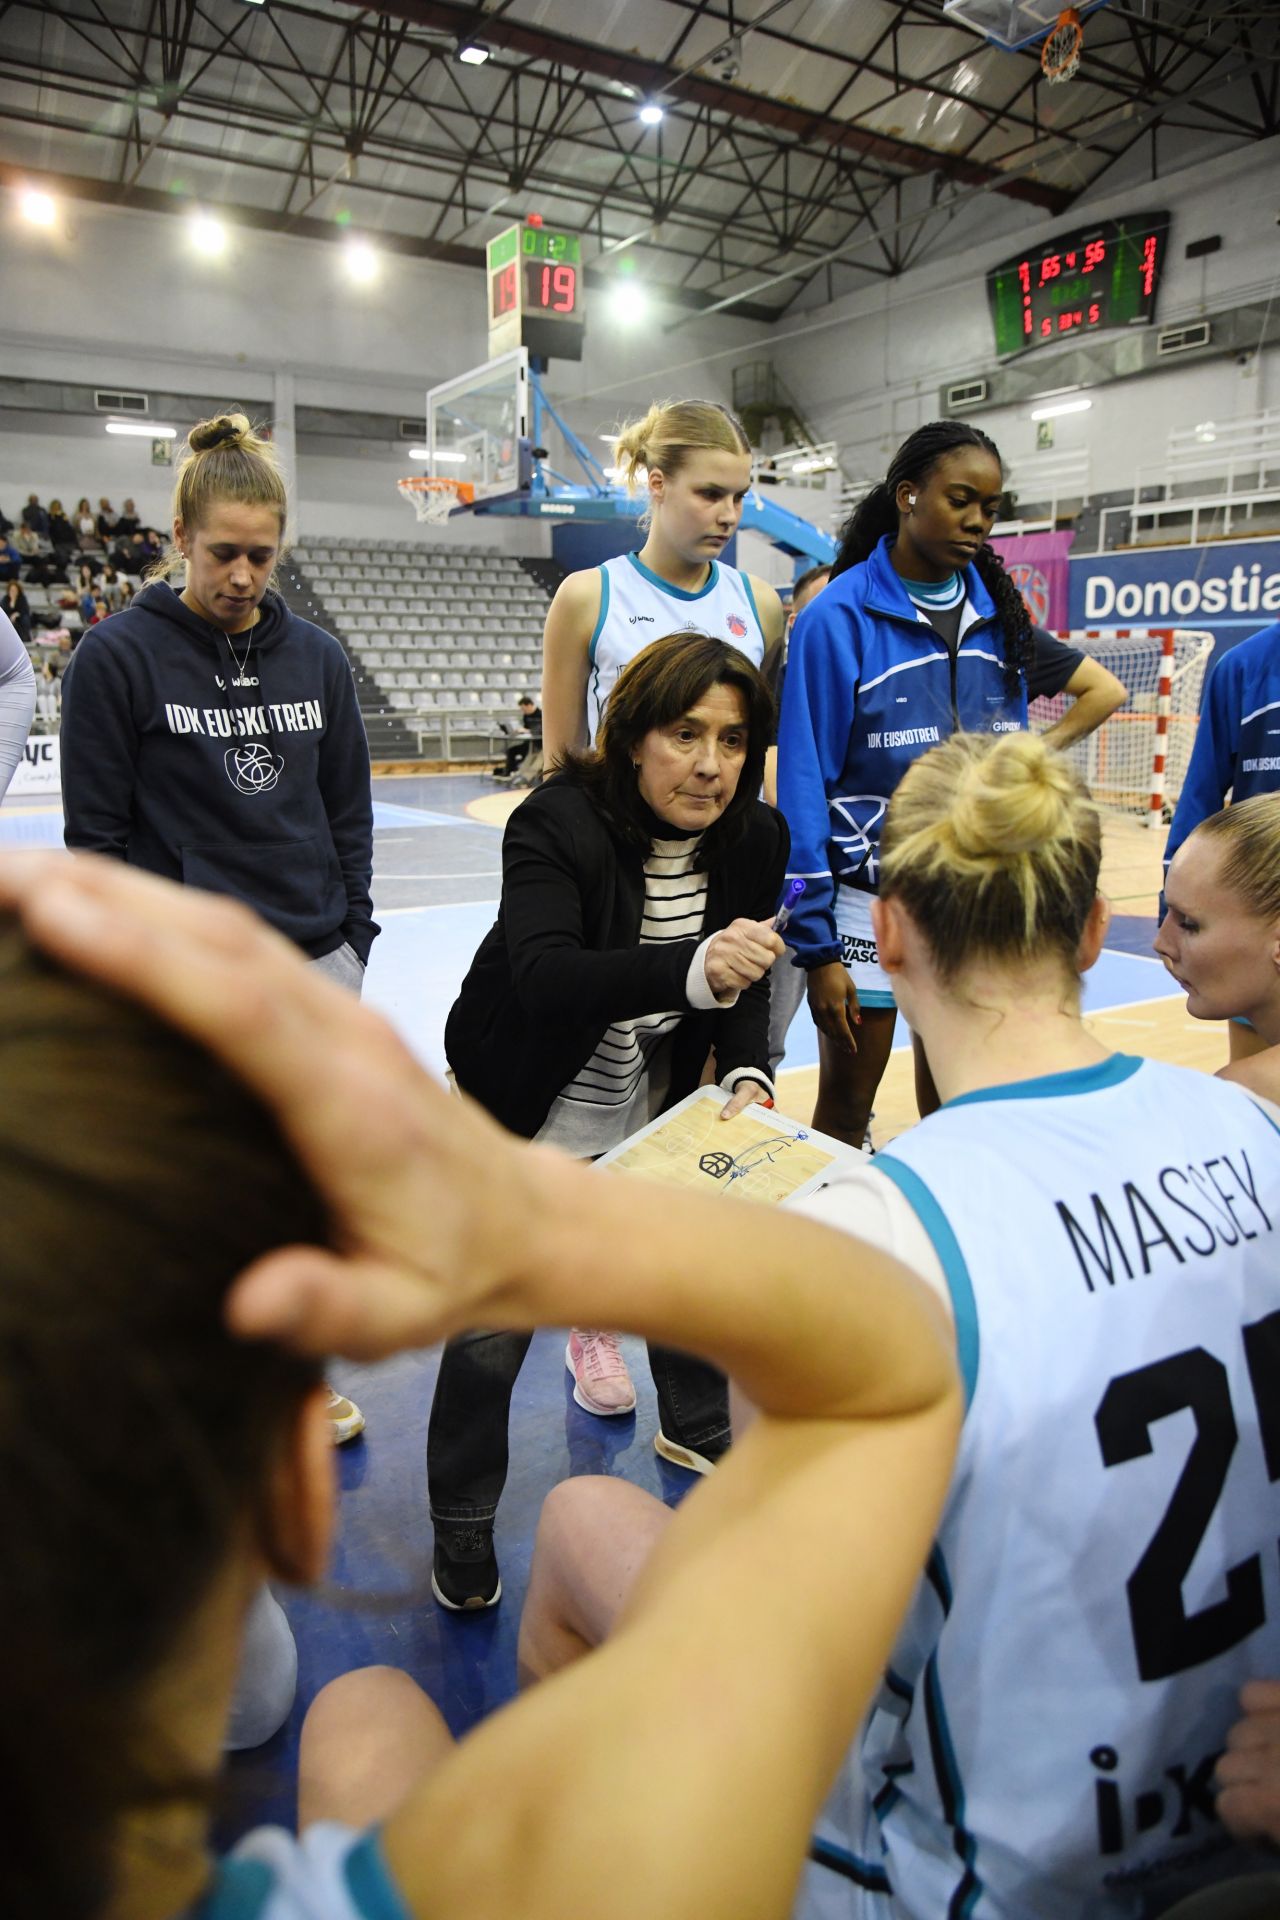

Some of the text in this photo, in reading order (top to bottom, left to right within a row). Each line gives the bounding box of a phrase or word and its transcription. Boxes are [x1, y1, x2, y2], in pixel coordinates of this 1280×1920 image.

[500, 263, 516, 312] 19
[541, 266, 575, 312] 19
[1085, 563, 1280, 619] Donostia
[165, 699, 324, 738] IDK EUSKOTREN
[867, 726, 940, 749] IDK EUSKOTREN
[1054, 1148, 1272, 1293] MASSEY
